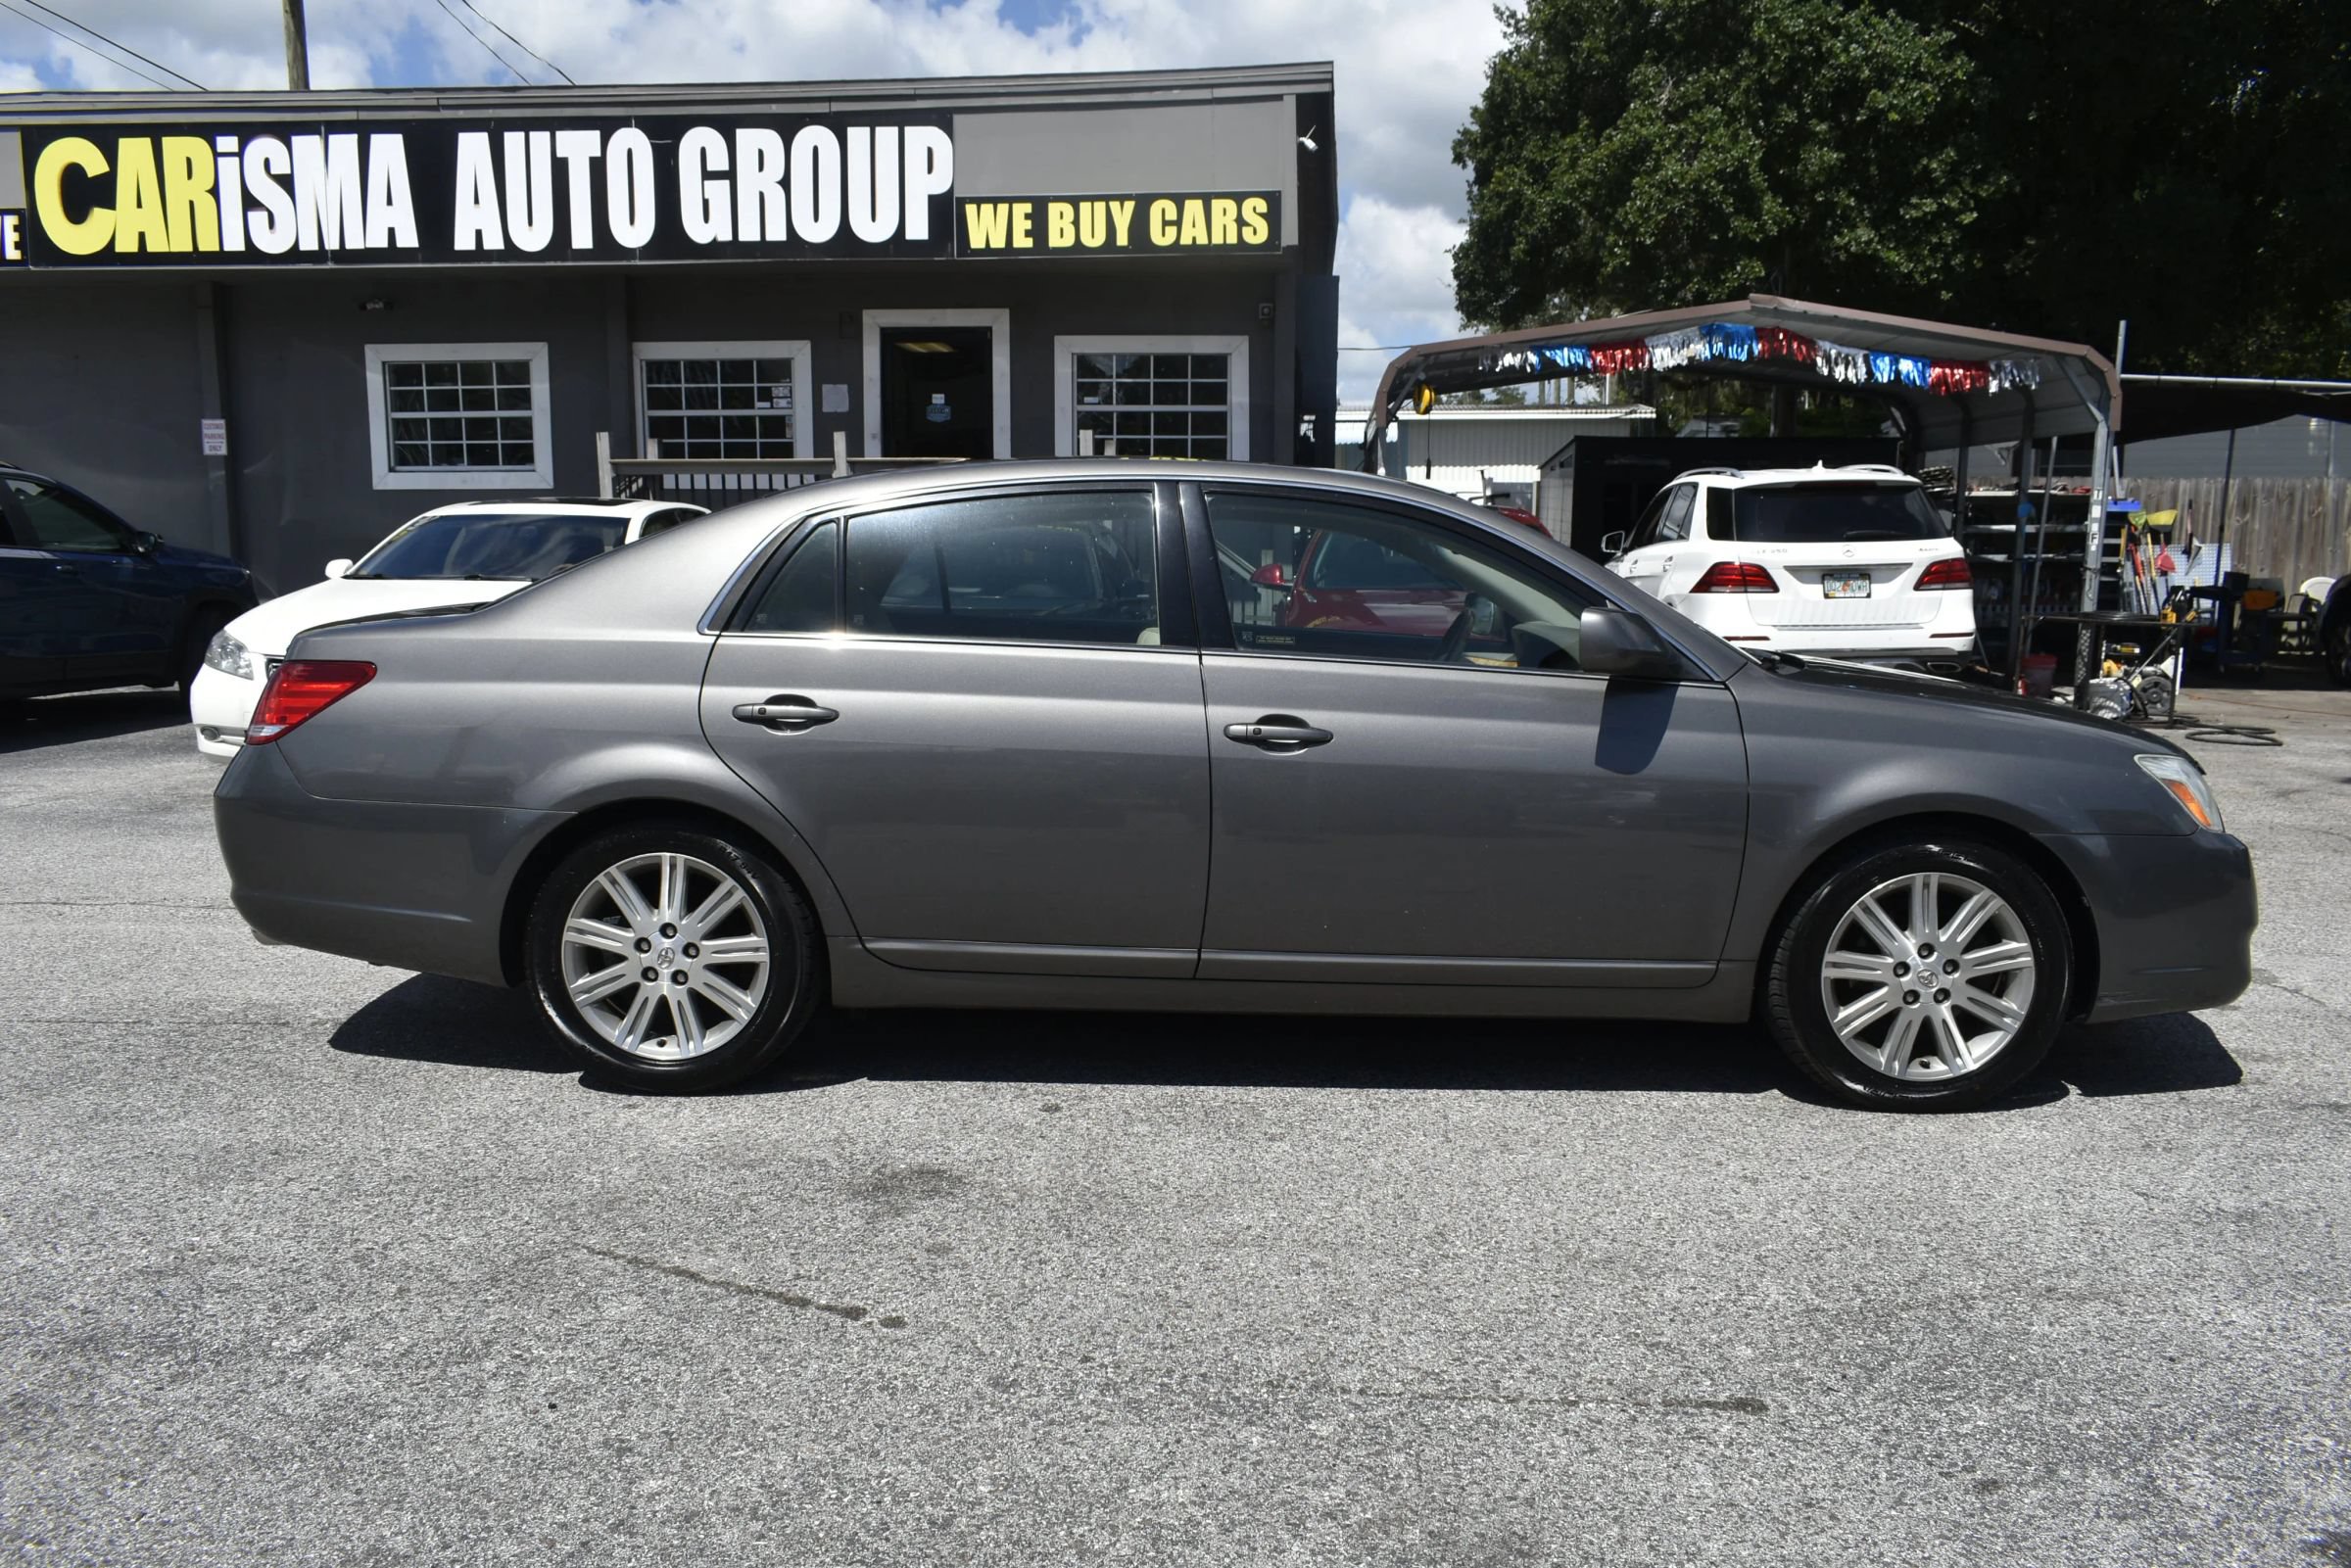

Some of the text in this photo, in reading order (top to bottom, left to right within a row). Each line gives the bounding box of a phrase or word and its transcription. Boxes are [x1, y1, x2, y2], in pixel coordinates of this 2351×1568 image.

[454, 127, 656, 253] AUTO
[678, 124, 955, 246] GROUP
[0, 214, 23, 261] E
[965, 197, 1270, 249] WE BUY CARS
